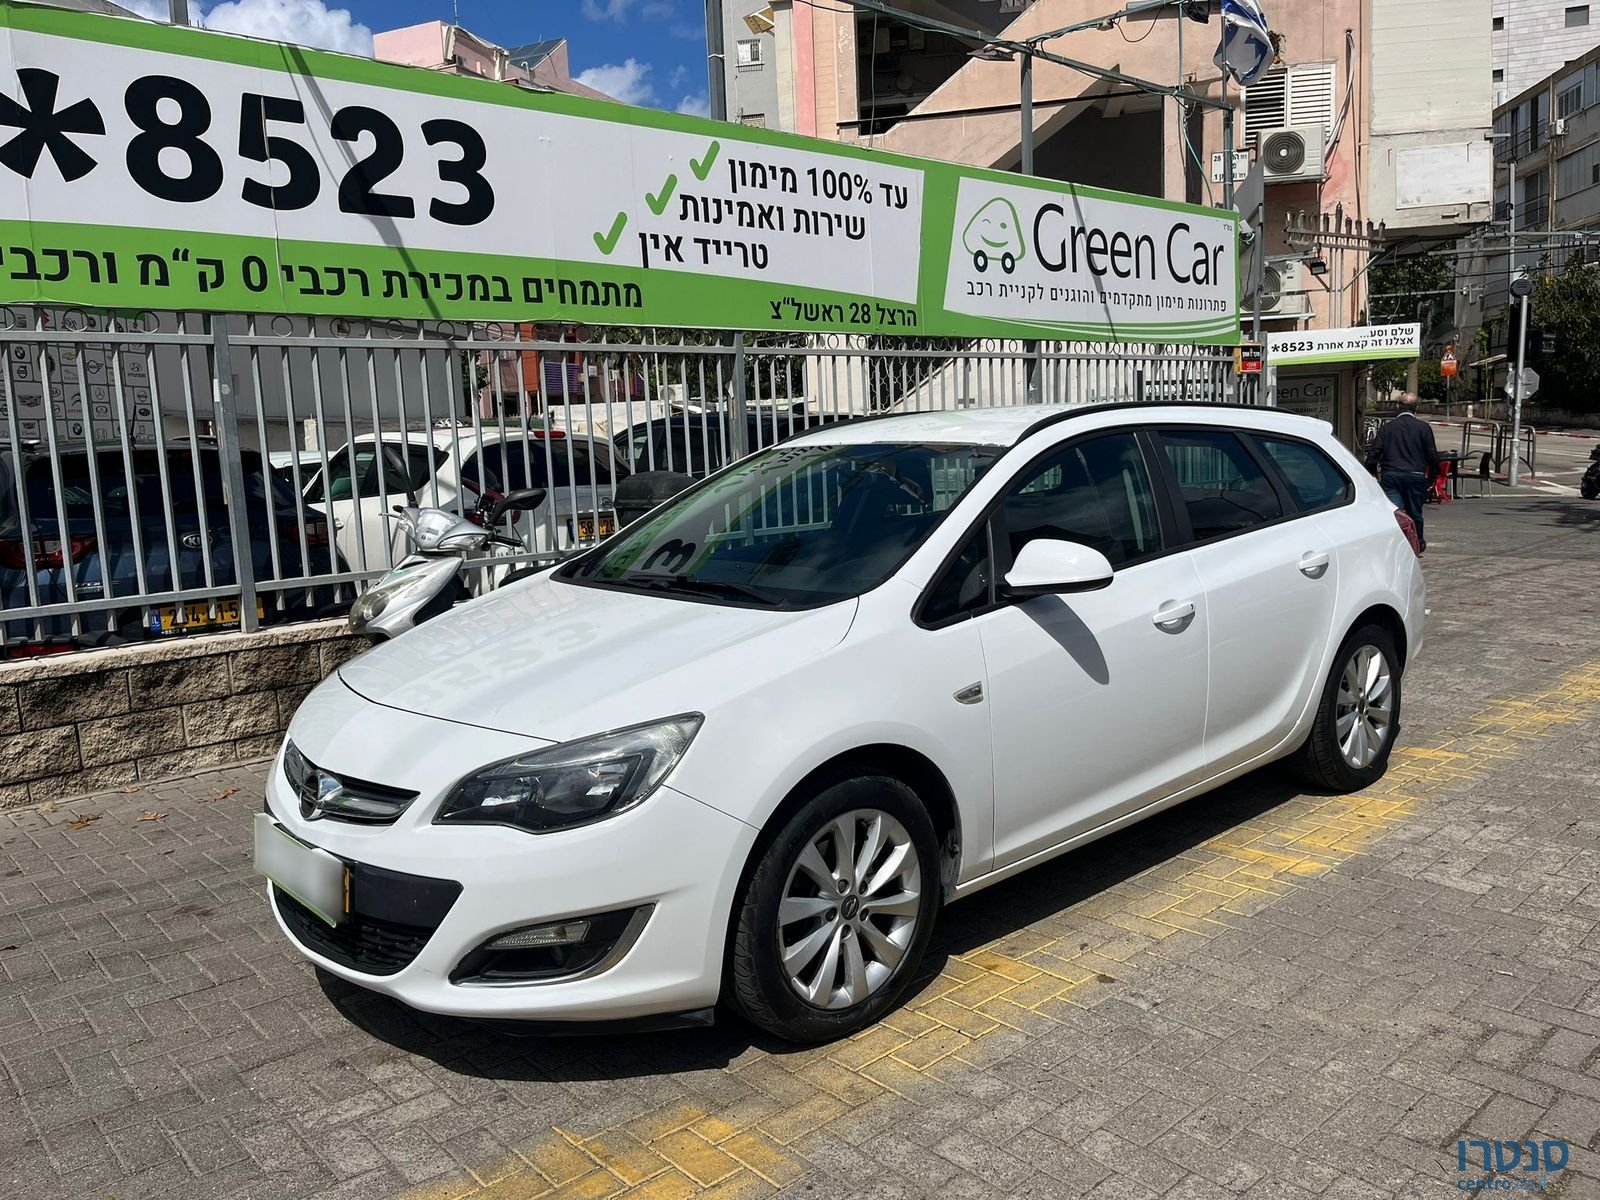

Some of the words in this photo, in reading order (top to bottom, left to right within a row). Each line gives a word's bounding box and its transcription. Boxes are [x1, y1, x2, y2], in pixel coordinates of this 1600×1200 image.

[728, 159, 798, 194] מימון
[807, 167, 873, 204] 100%
[879, 182, 908, 209] עד
[679, 193, 785, 232] ואמינות
[793, 208, 866, 240] שירות
[638, 232, 685, 269] אין
[694, 237, 769, 269] טרייד
[1033, 203, 1156, 280] Green
[1166, 222, 1225, 286] Car
[242, 255, 268, 293] 0
[281, 264, 370, 297] רכבי
[382, 270, 512, 302] במכירת
[522, 277, 643, 308] מתמחים
[967, 281, 993, 296] רכב
[999, 283, 1044, 303] לקניית
[1050, 287, 1094, 303] והוגנים
[1100, 291, 1152, 309] מתקדמים
[1156, 296, 1184, 311] מימון
[1187, 297, 1227, 312] פתרונות
[849, 302, 871, 324] 28
[876, 303, 917, 326] הרצל
[1385, 337, 1414, 346] אצלנו
[1390, 327, 1414, 337] שלם
[1317, 342, 1343, 350] אחרת
[1347, 340, 1368, 349] קצת
[1303, 382, 1329, 397] Car
